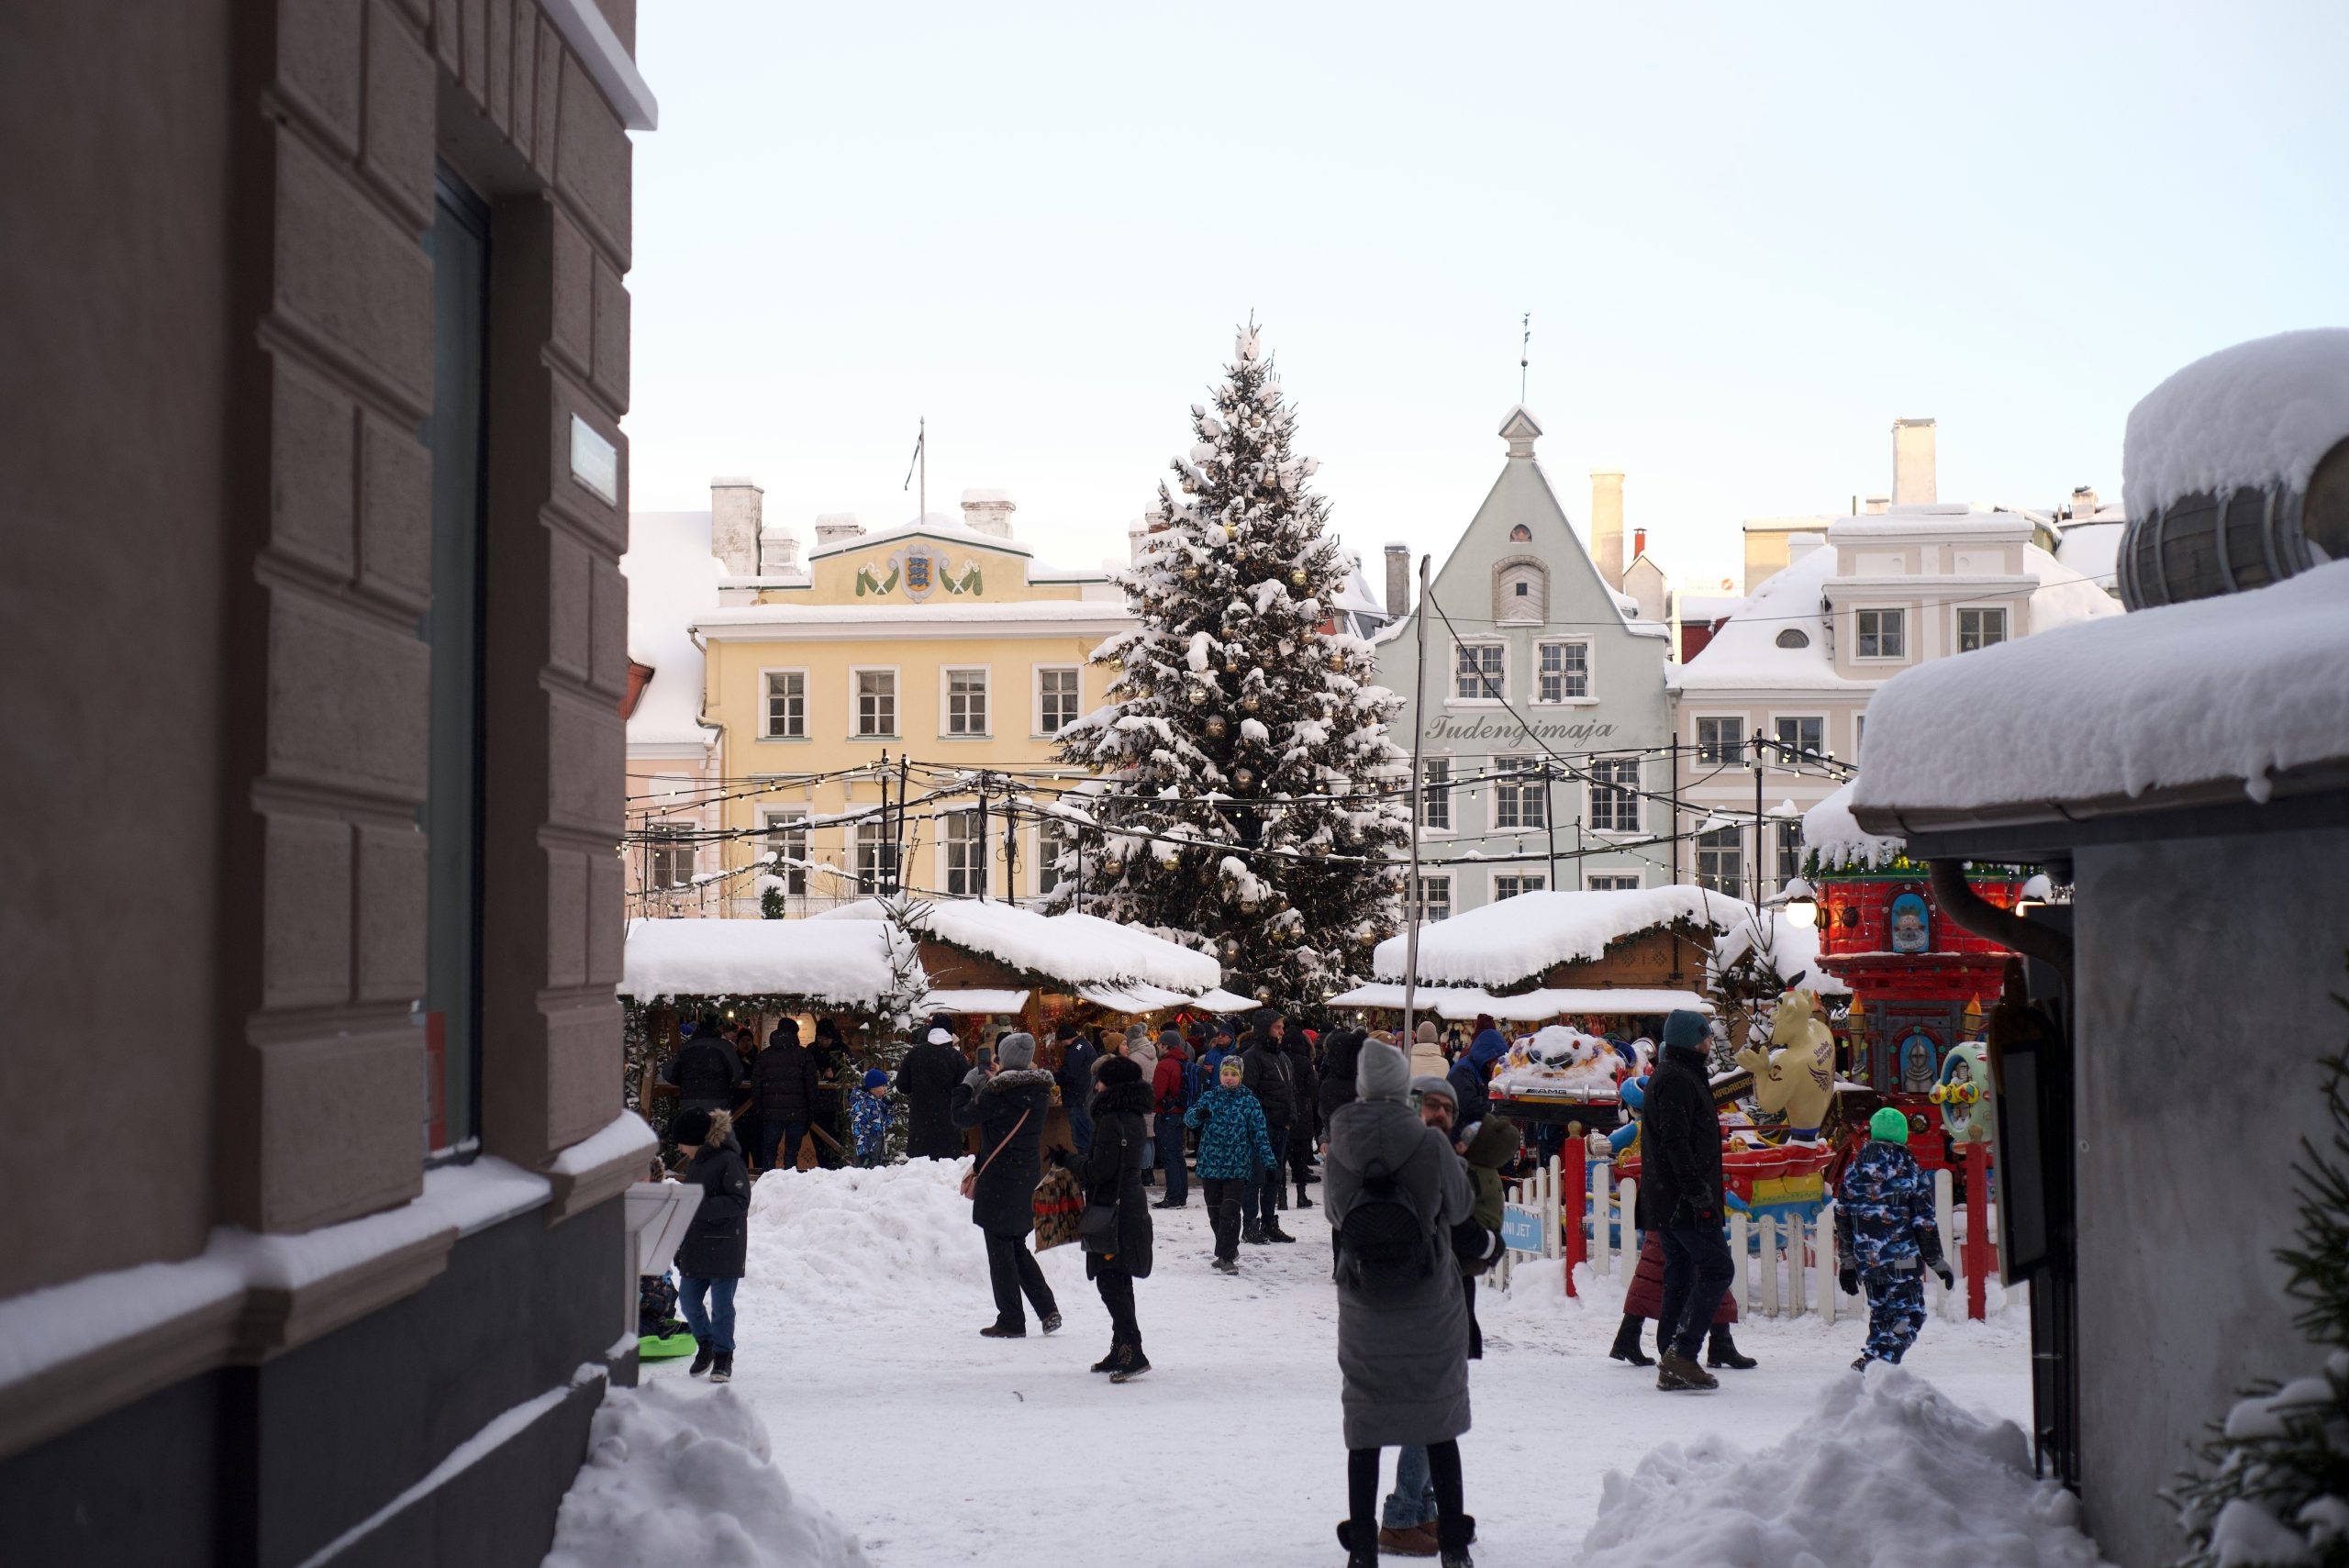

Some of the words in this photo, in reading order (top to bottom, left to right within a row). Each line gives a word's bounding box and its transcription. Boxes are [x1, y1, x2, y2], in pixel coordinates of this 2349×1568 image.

[1425, 715, 1620, 748] Tudengimaja
[1502, 1221, 1514, 1236] INI
[1516, 1223, 1531, 1238] JET
